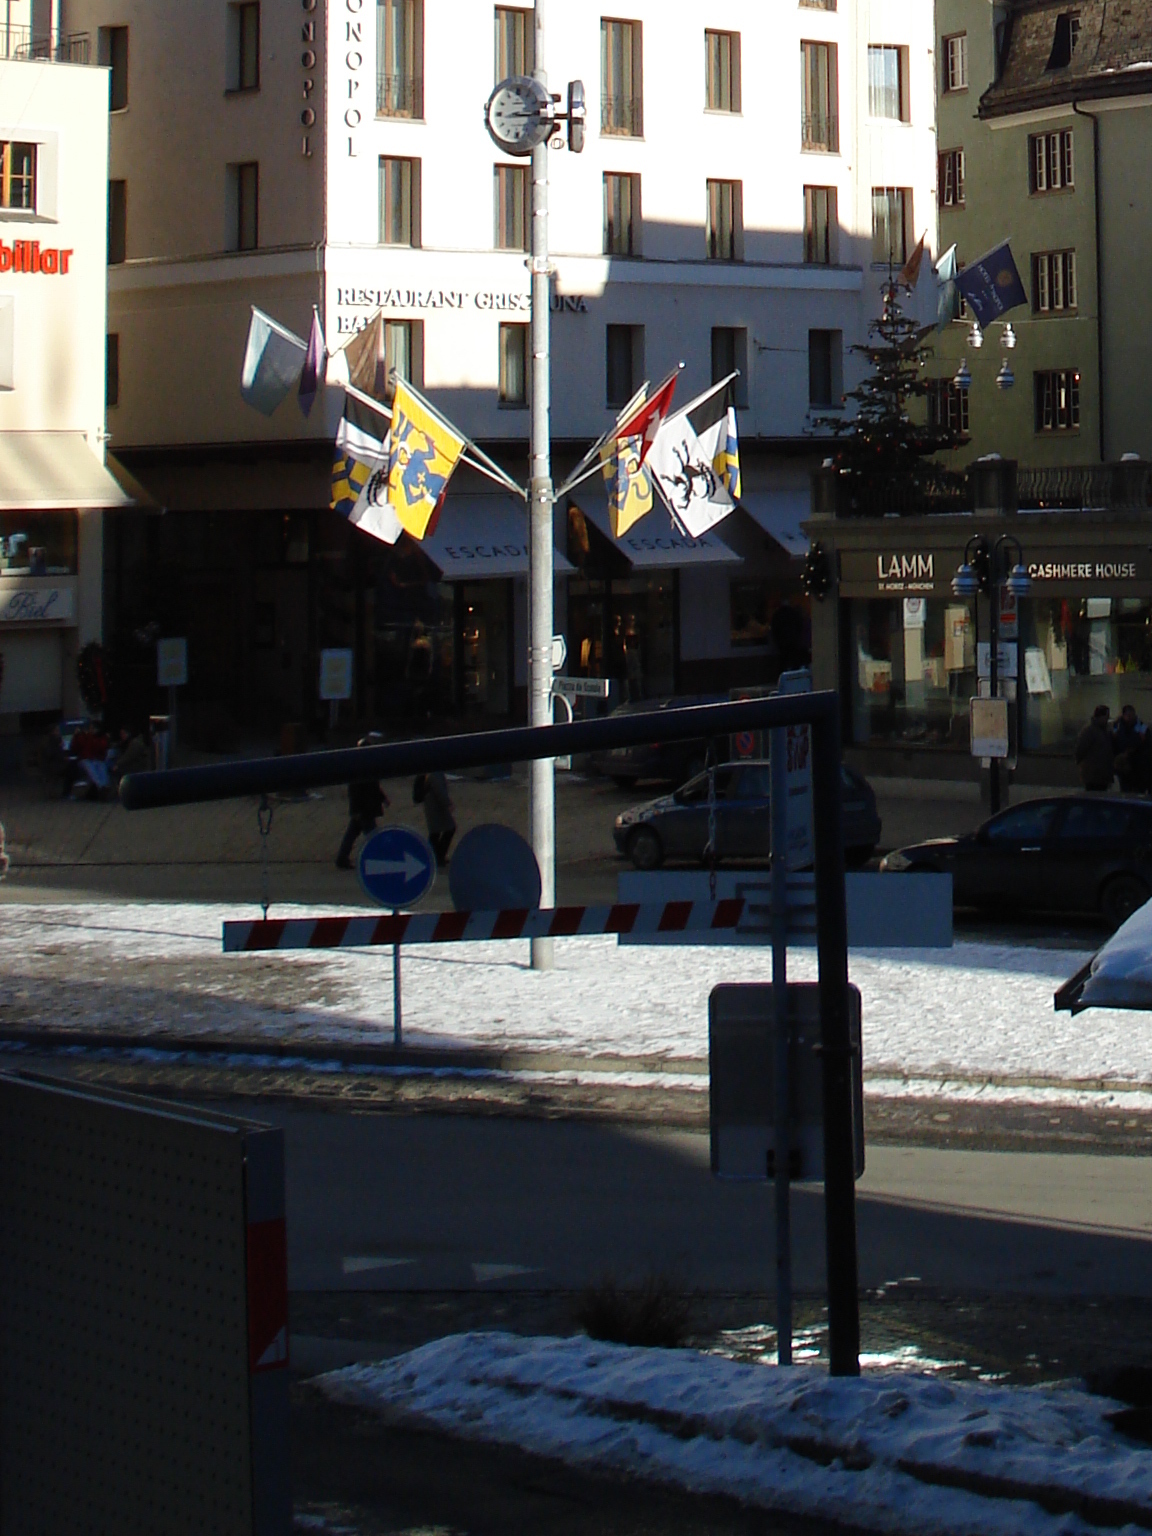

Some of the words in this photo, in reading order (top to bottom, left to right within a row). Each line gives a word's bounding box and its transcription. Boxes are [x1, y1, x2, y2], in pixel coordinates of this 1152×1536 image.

[337, 287, 469, 309] RESTAURANT
[474, 291, 588, 313] GRISCUNA
[877, 554, 934, 579] LAMM
[1028, 563, 1093, 579] CASHMERE
[1095, 562, 1136, 579] HOUSE
